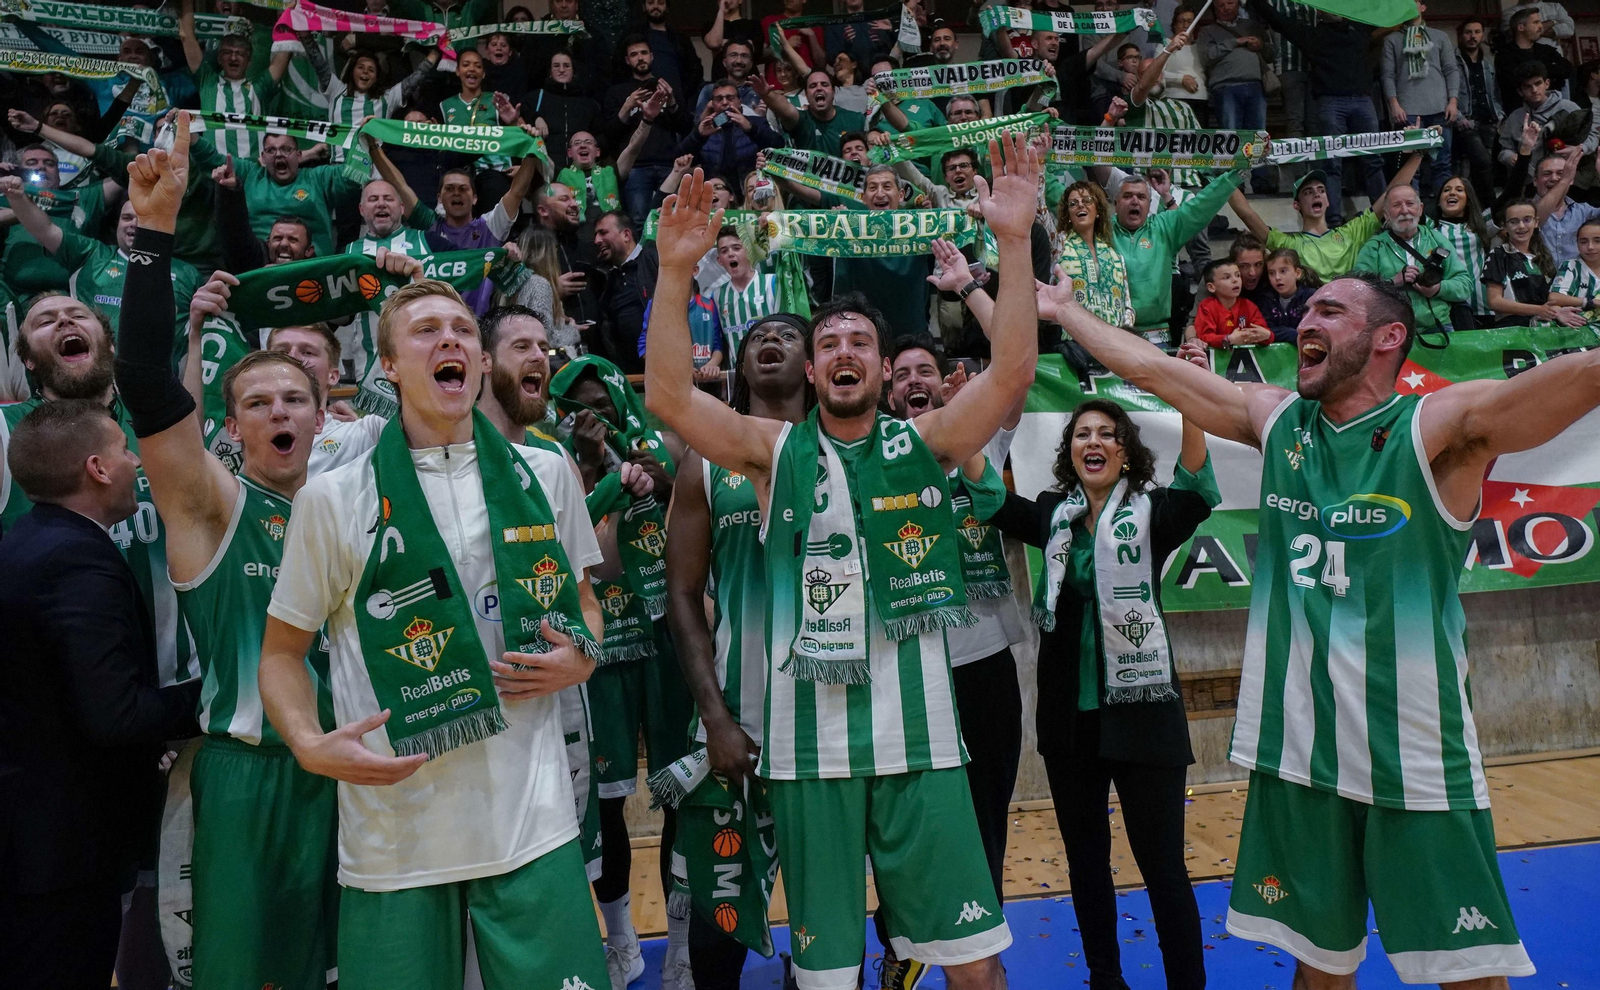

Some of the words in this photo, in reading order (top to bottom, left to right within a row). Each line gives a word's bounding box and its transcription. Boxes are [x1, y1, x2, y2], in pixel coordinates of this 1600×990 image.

[42, 3, 213, 33] VALDEMOO
[1072, 11, 1107, 20] ESTAMOS
[1108, 10, 1132, 19] LOCOS
[1058, 21, 1068, 29] DE
[1070, 22, 1079, 30] LA
[1081, 22, 1111, 30] CABEZA
[934, 60, 1043, 84] VALDEMORO
[402, 133, 501, 153] BALONCESTO
[952, 119, 1035, 148] BALONCESTO
[1095, 129, 1114, 138] 1994
[1120, 130, 1241, 155] VALDEMORO
[1324, 135, 1342, 151] de
[792, 150, 810, 159] 1994
[781, 210, 882, 240] REAL
[891, 210, 977, 239] BETI
[424, 260, 467, 278] ACB
[879, 417, 913, 461] CB
[110, 501, 159, 550] 40
[718, 509, 762, 529] energ
[1330, 504, 1387, 528] plus
[963, 551, 995, 563] RealBetis
[1289, 533, 1350, 598] 24
[638, 560, 667, 578] RealB
[889, 569, 946, 591] RealBetis
[890, 594, 923, 610] energia
[927, 590, 947, 602] plus
[604, 616, 640, 631] ealBetis
[603, 633, 623, 643] nergia
[400, 667, 472, 702] RealBetis
[404, 703, 447, 725] energia
[450, 691, 474, 710] plus
